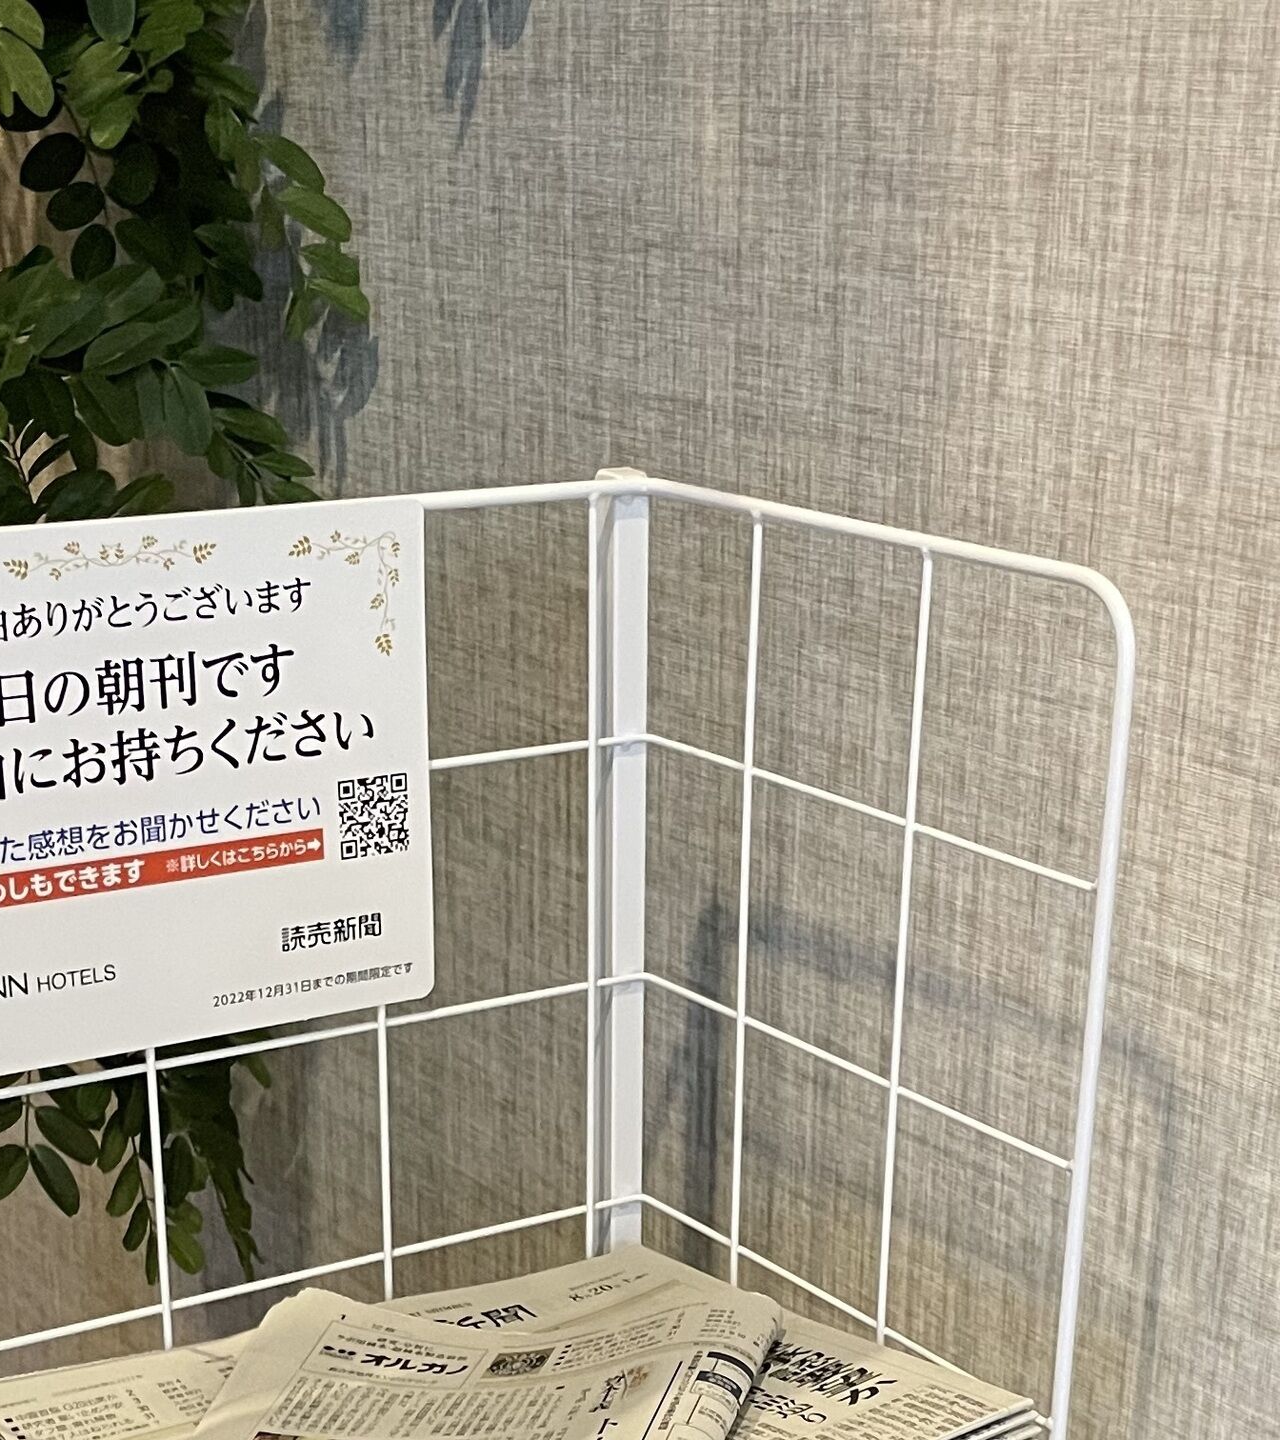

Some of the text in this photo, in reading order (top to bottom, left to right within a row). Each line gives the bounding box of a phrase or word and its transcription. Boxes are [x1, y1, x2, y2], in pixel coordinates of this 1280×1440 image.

[281, 912, 382, 952] 読売新聞
[36, 964, 117, 993] HOTELS
[213, 961, 414, 1008] 2022年12月31日までの期間限定です
[360, 1353, 470, 1376] オルガノ
